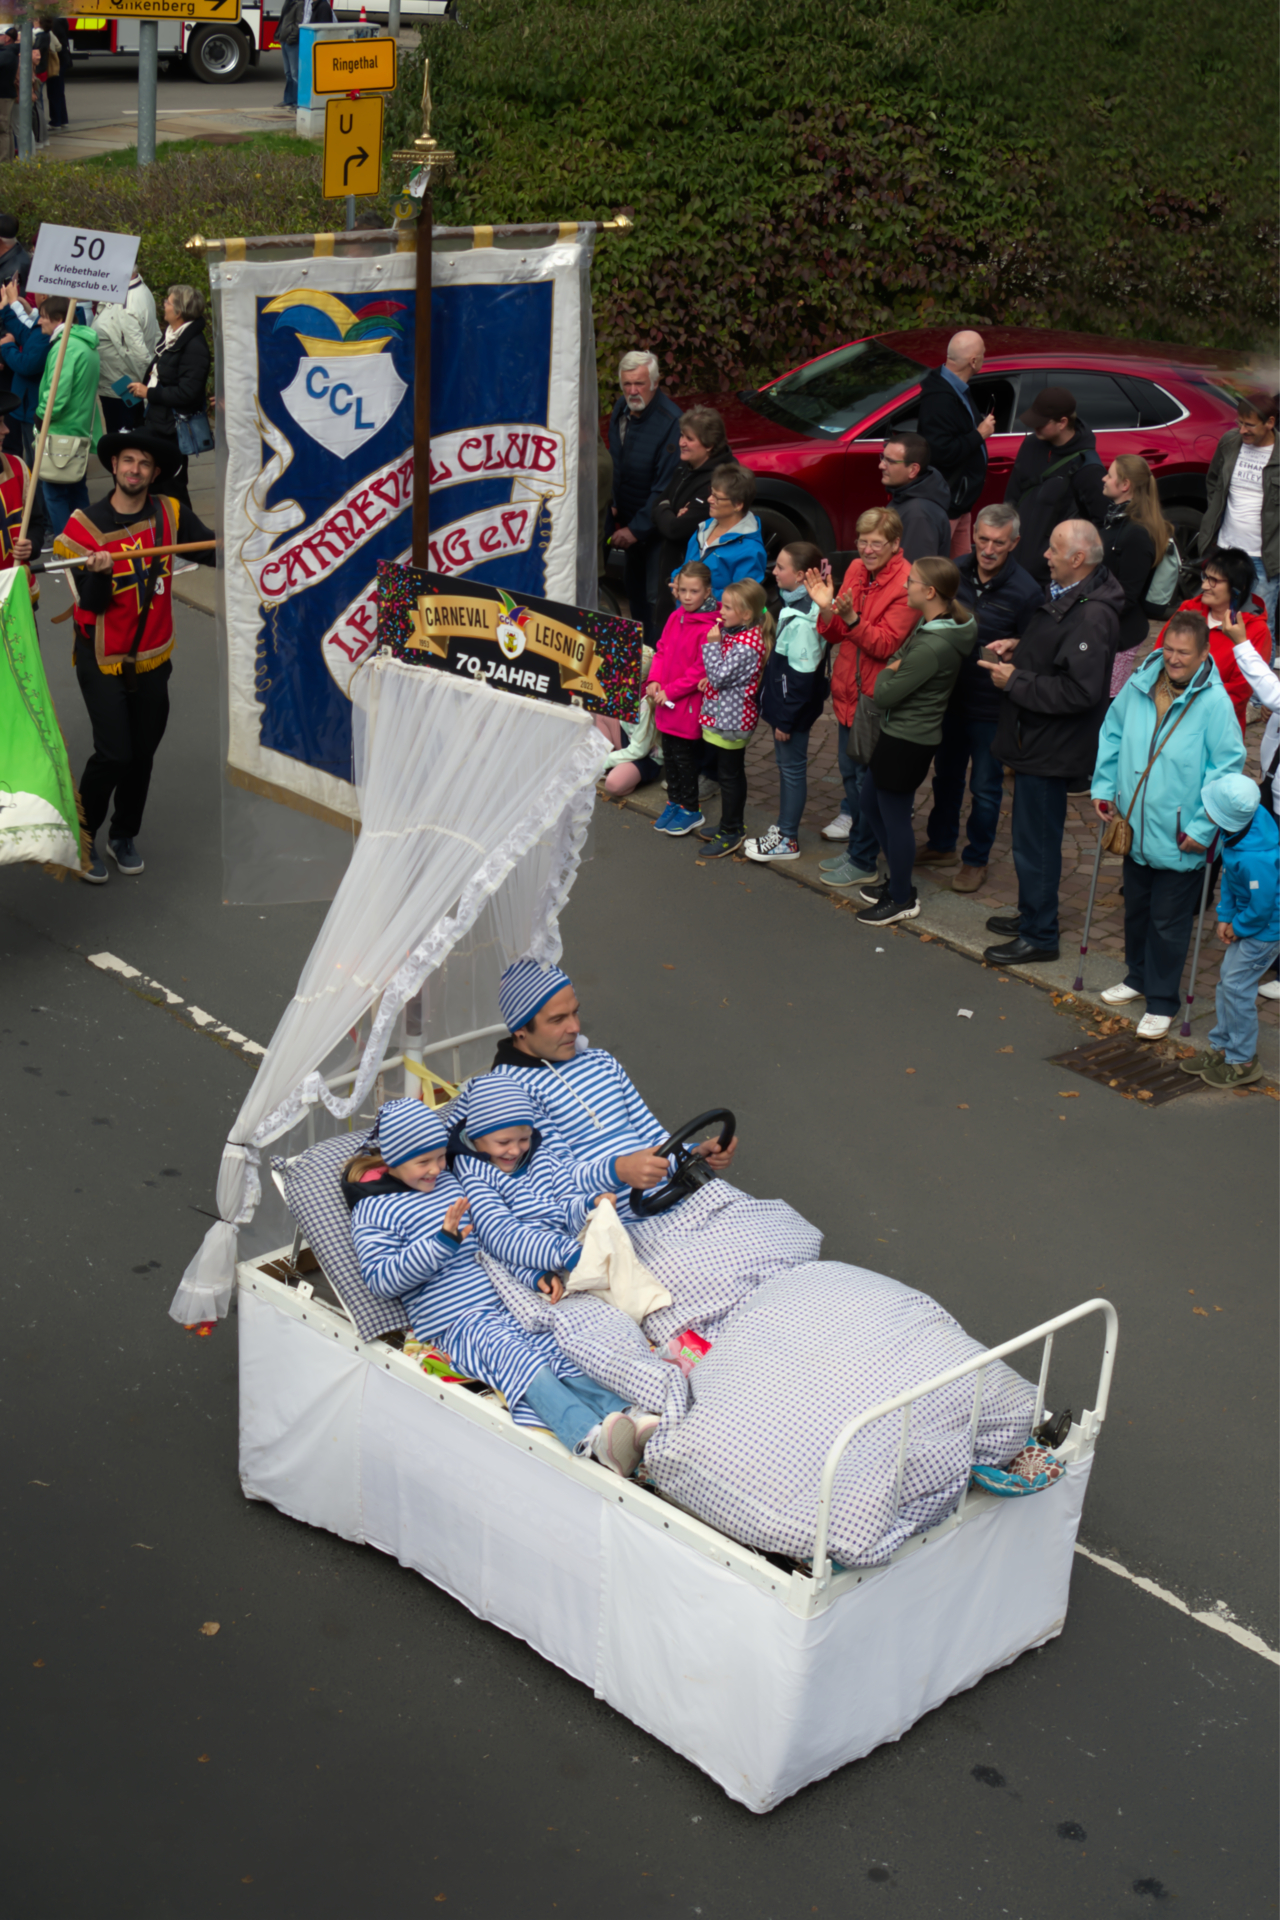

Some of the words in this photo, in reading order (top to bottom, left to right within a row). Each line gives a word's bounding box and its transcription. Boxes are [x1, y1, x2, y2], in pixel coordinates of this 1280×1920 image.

[332, 54, 379, 74] Ringethal
[339, 113, 353, 135] U
[70, 235, 105, 261] 50
[53, 263, 111, 279] Kriebethaler
[38, 274, 100, 290] Faschingsclub
[101, 284, 119, 293] e.V.
[305, 364, 376, 430] CCL
[457, 432, 559, 473] CLUB
[1239, 461, 1263, 471] ETHAN
[1238, 471, 1262, 482] RILEY
[499, 614, 514, 627] CCL
[418, 638, 430, 649] 1953
[425, 606, 490, 629] CARNEVAL
[535, 622, 586, 663] LEISNIG
[455, 652, 481, 674] 70
[484, 660, 551, 694] JAHRE
[580, 680, 594, 691] 2023
